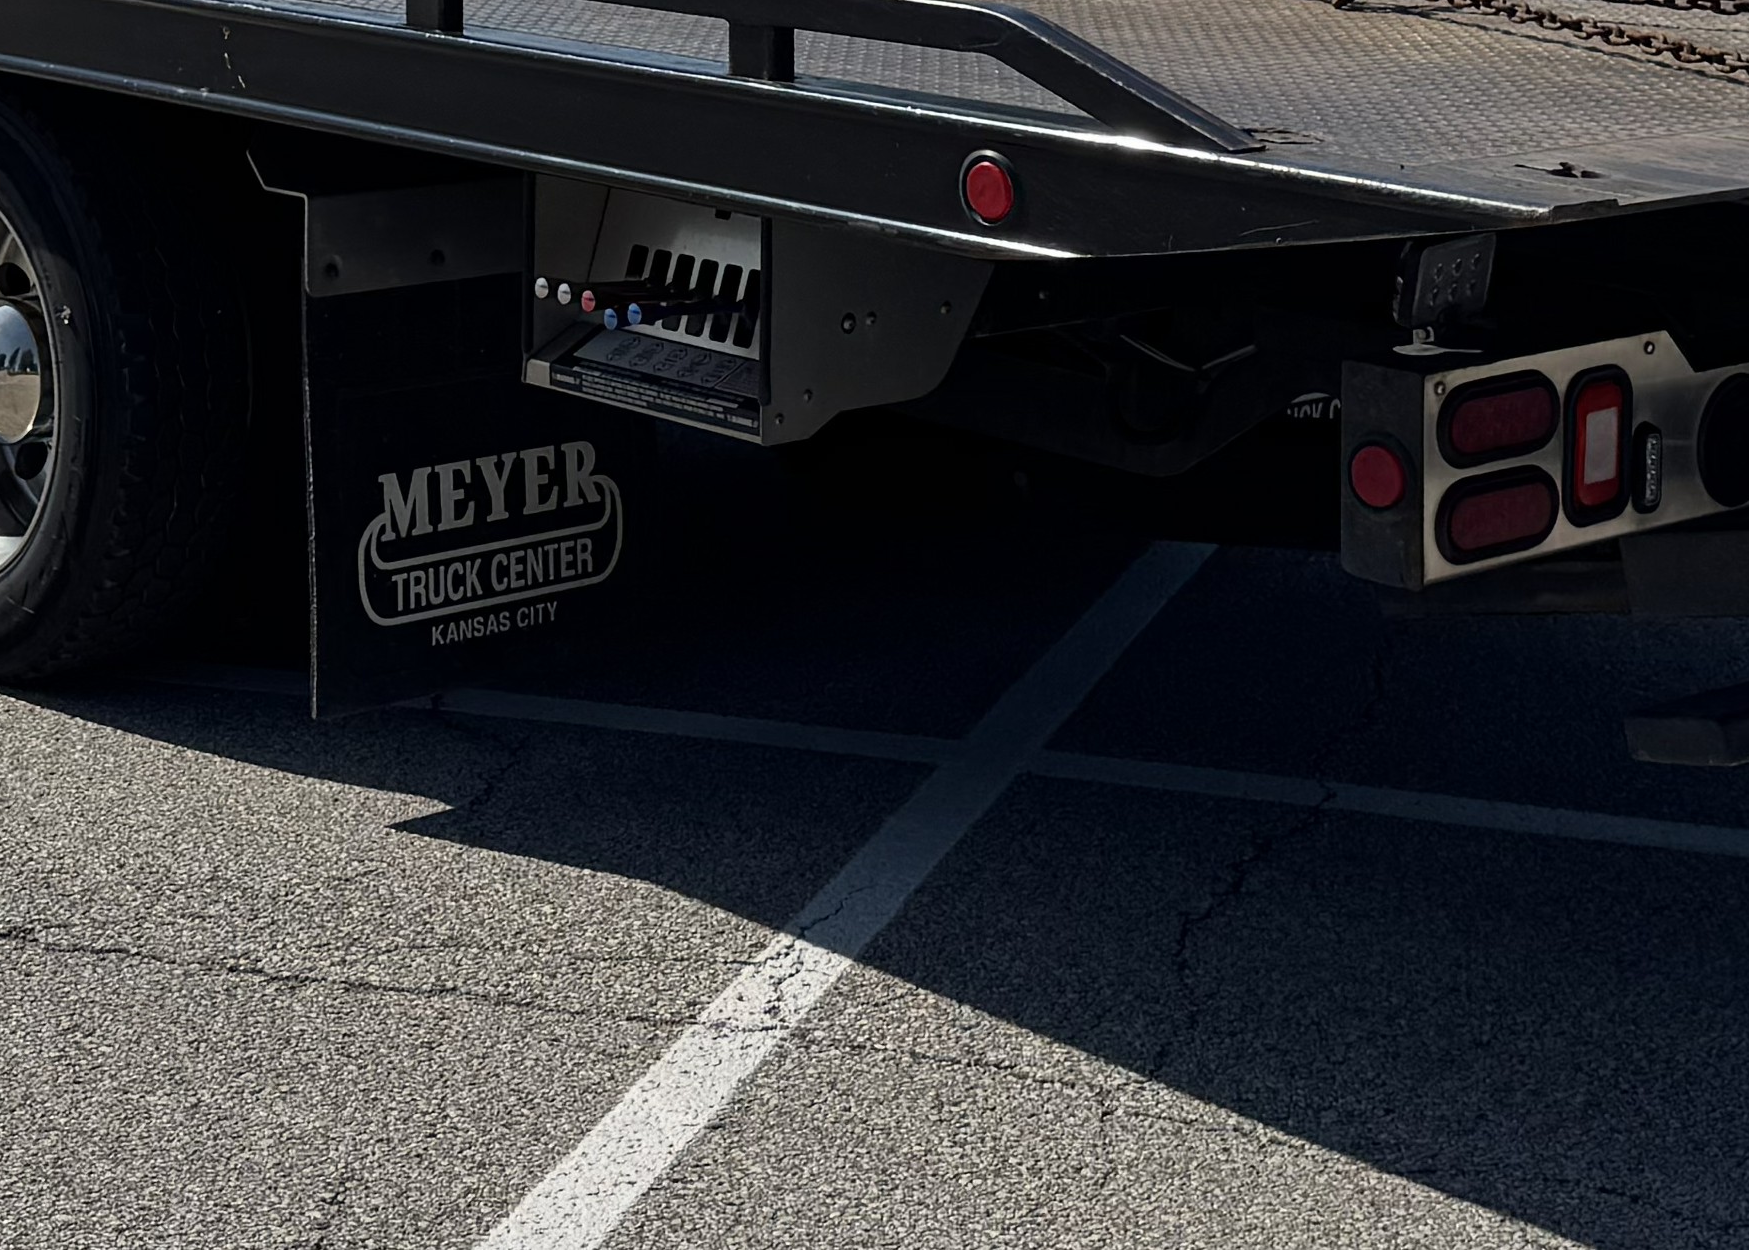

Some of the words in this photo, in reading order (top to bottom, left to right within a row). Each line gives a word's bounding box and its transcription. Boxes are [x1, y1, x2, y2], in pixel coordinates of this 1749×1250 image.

[378, 440, 602, 542] MEYER
[391, 558, 483, 612] TRUCK
[491, 538, 593, 592] CENTER
[432, 611, 511, 646] KANSAS
[516, 601, 558, 628] CITY
